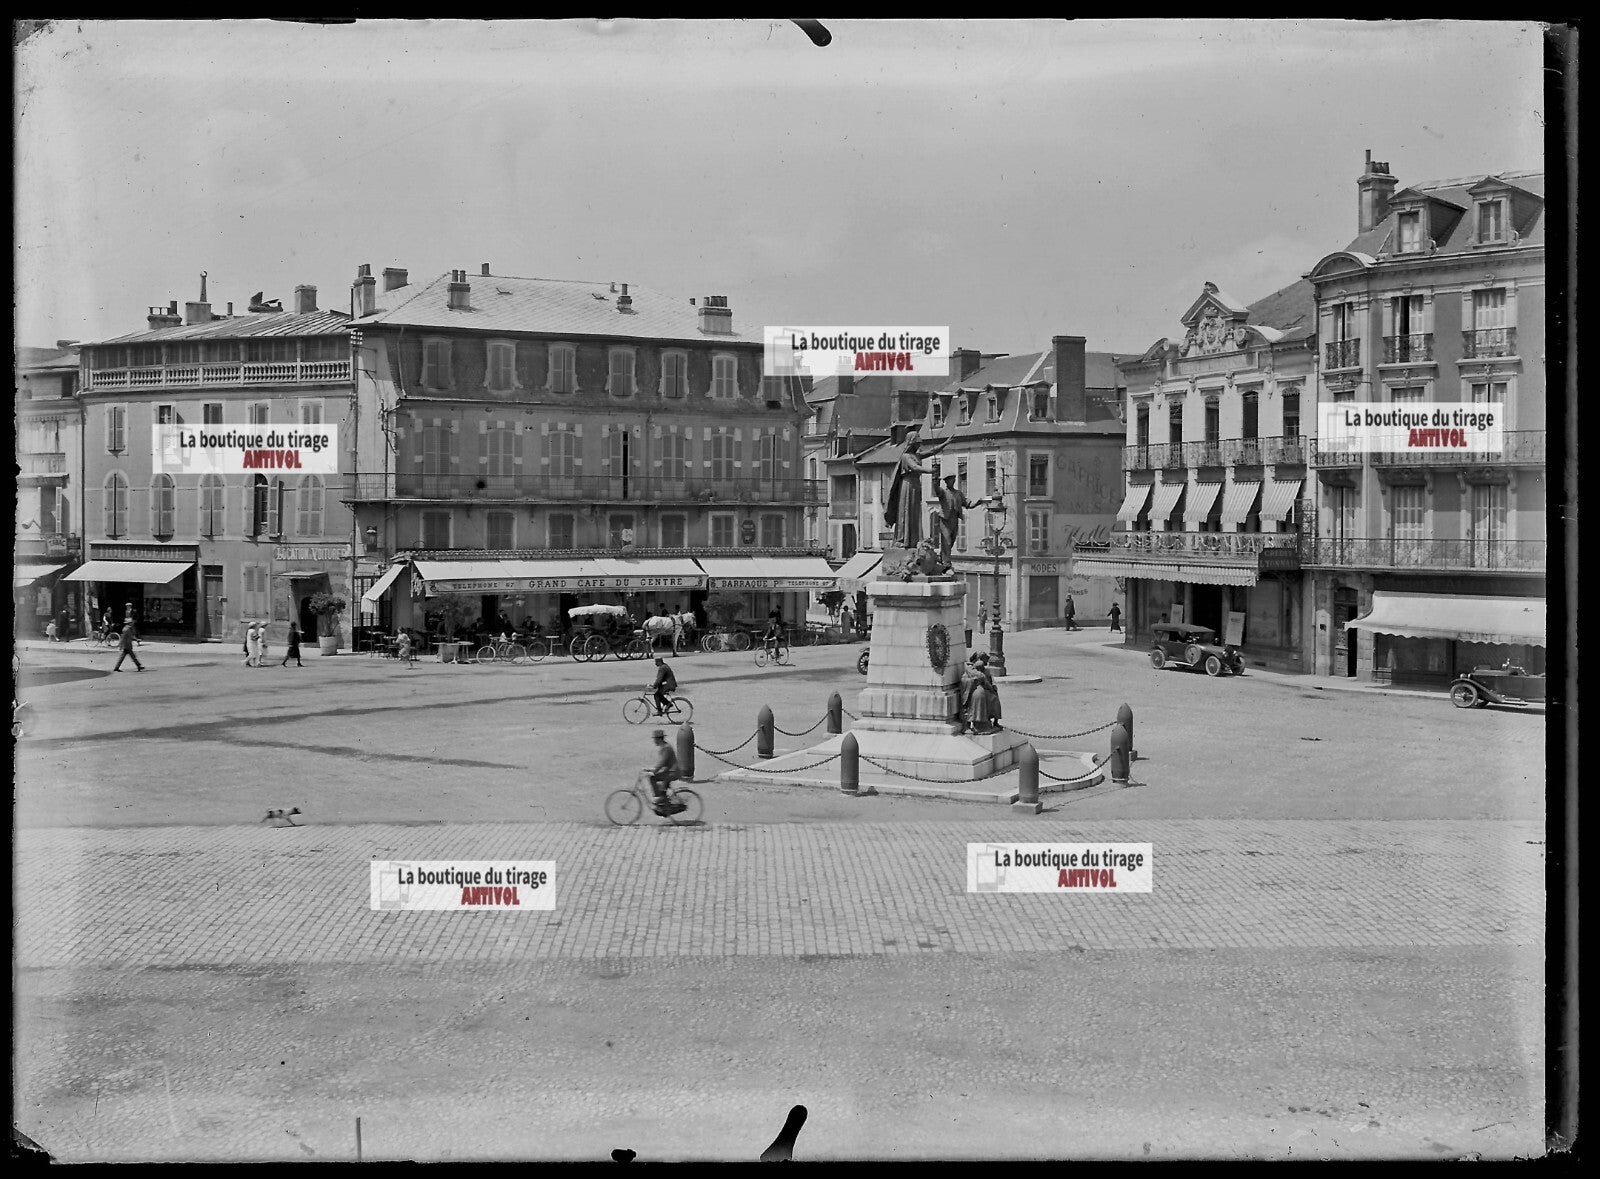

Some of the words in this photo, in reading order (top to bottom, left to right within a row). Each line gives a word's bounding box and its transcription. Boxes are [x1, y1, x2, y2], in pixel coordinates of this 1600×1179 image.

[99, 547, 184, 559] HORLOGERIE
[1031, 563, 1057, 573] MODES
[453, 582, 498, 590] TELEPHONE
[528, 580, 567, 589] GRAND
[577, 579, 606, 588] CAFE
[615, 578, 630, 587] DU
[640, 578, 683, 586] CENTRE
[721, 580, 768, 589] BARRAQUE
